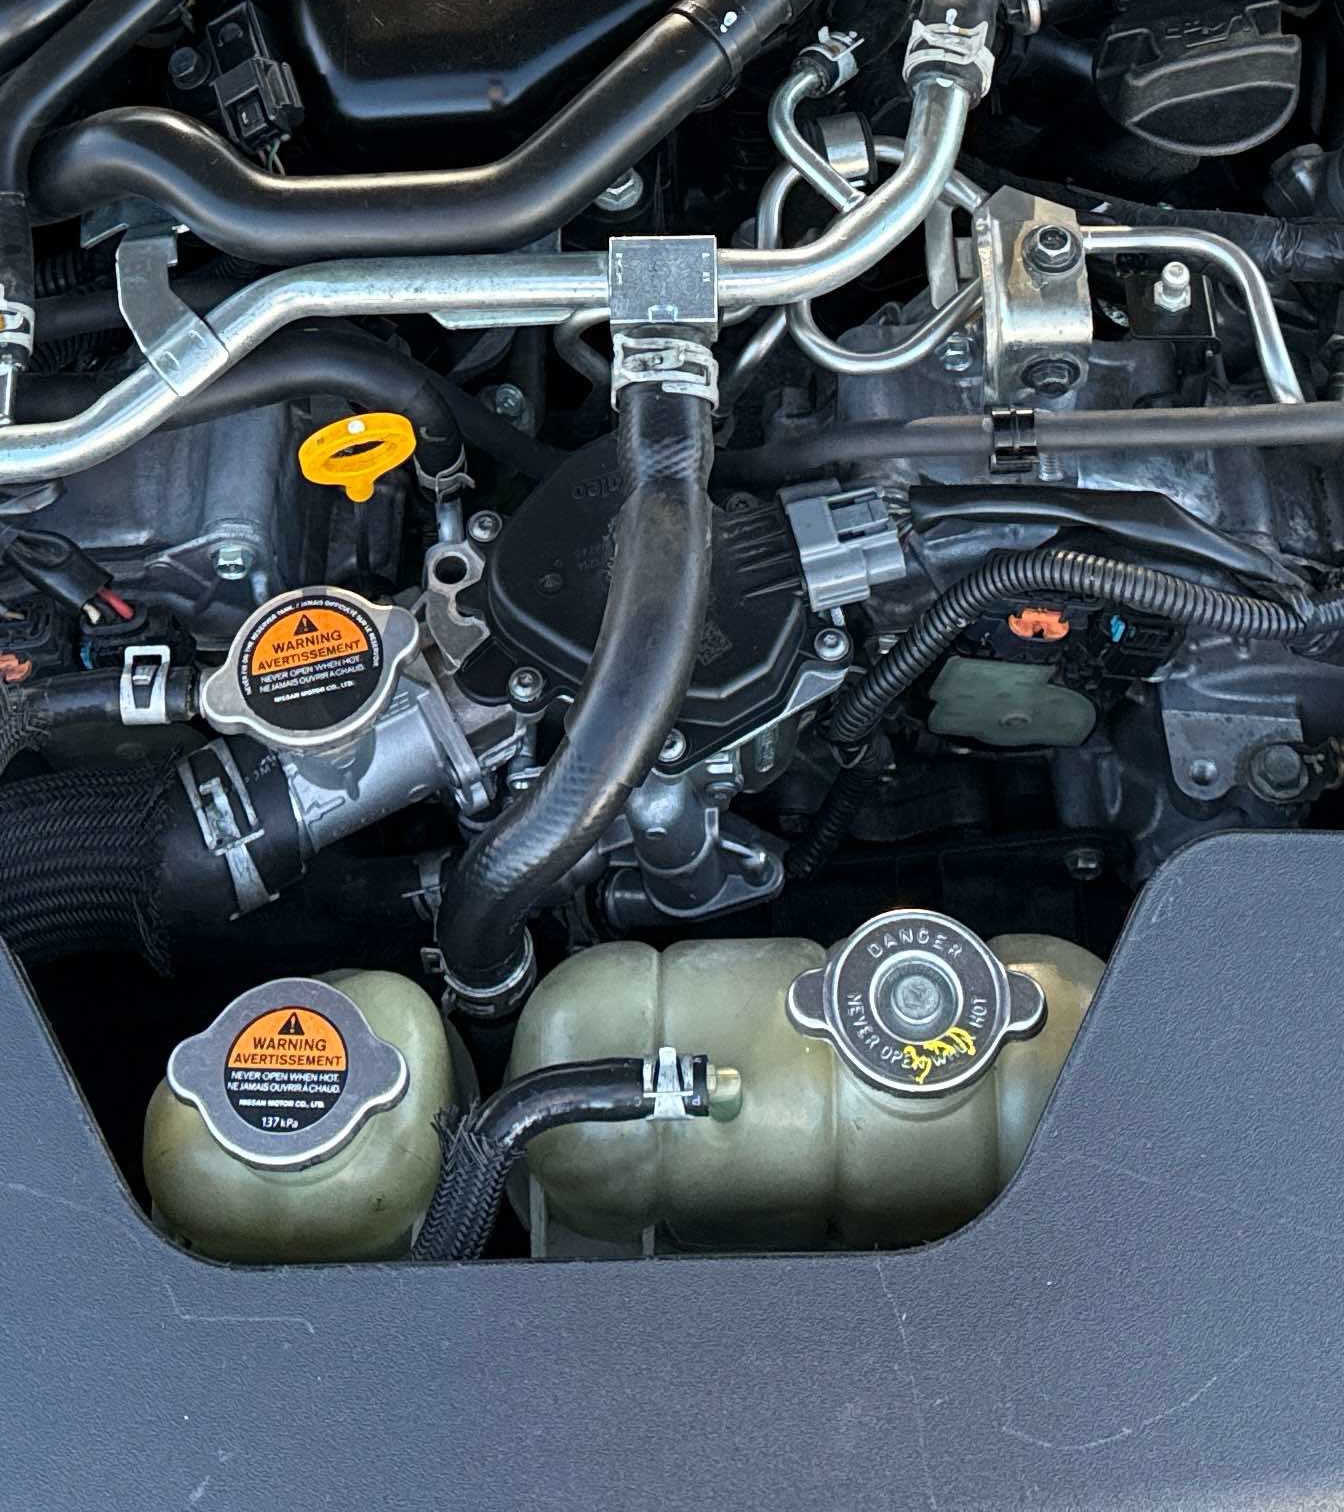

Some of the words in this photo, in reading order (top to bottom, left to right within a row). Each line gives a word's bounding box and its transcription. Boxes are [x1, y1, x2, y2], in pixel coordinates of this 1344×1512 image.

[272, 630, 342, 654] WARNING
[258, 639, 361, 671] AVERTISSEMENT
[260, 669, 289, 684] NEVER
[290, 665, 314, 679] OPEN
[312, 660, 342, 675] WHEN
[259, 683, 270, 693] NE
[270, 678, 300, 692] JAMAIS
[299, 671, 330, 685] OUVRIR
[274, 691, 300, 703] NISSAN
[301, 687, 325, 697] MOTOR
[866, 927, 963, 959] DANGER
[847, 992, 881, 1050] NEVER
[969, 997, 988, 1029] HOT
[253, 1037, 326, 1052] WARNING
[233, 1053, 343, 1067] AVERTISSEMENT
[231, 1071, 262, 1080] NEVER
[262, 1071, 288, 1081] OPEN
[289, 1072, 319, 1082] WHEN
[227, 1082, 239, 1091] NE
[239, 1082, 269, 1092] JAMAIS
[269, 1083, 302, 1092] OUVRIR
[239, 1099, 267, 1107] NISSAN
[268, 1099, 295, 1108] MOTOR
[261, 1116, 280, 1128] 137
[280, 1116, 298, 1129] kPa
